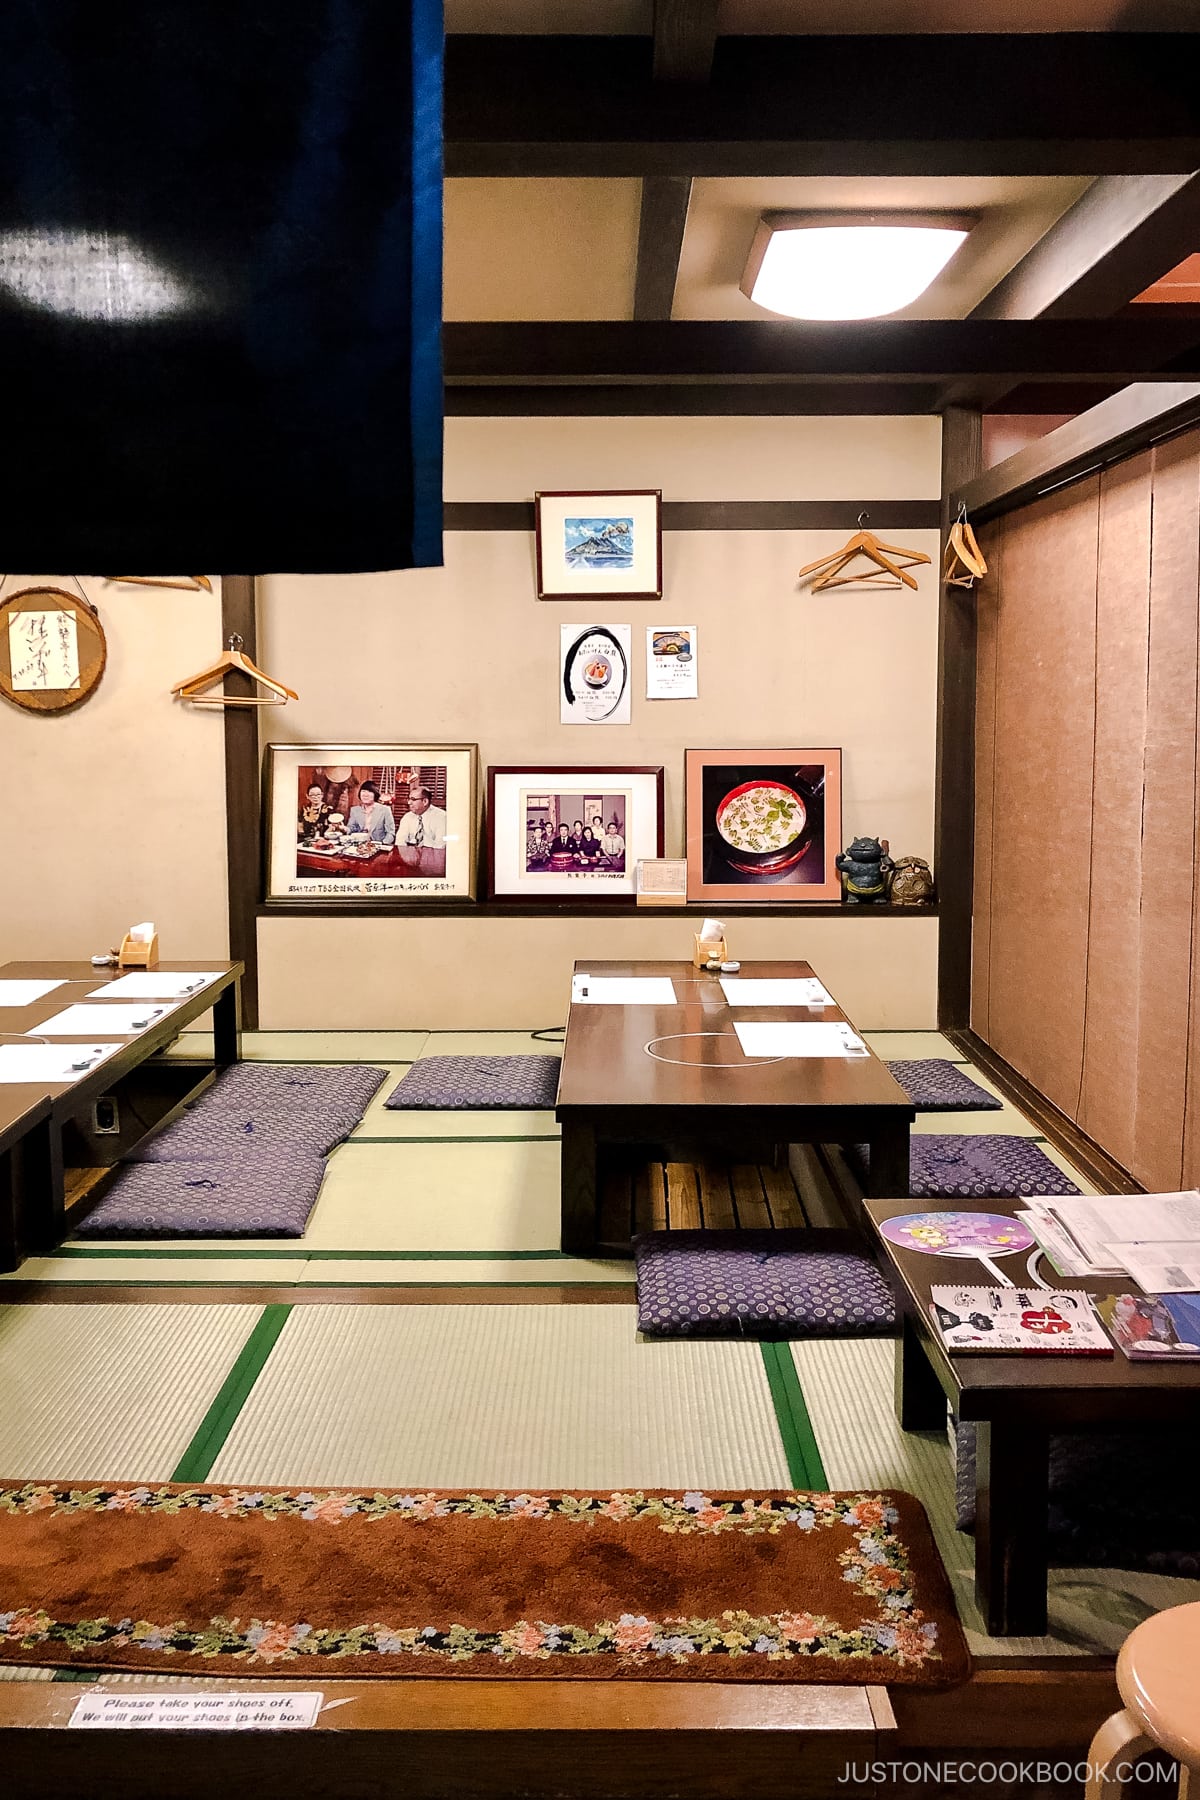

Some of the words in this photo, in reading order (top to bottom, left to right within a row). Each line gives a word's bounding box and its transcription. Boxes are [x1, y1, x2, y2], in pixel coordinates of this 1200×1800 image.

[103, 1699, 155, 1708] Please
[160, 1699, 189, 1708] take
[193, 1699, 224, 1709] your
[227, 1698, 266, 1708] shoes
[269, 1698, 294, 1708] off.
[82, 1712, 101, 1722] We
[104, 1712, 128, 1722] will
[129, 1712, 154, 1723] put
[158, 1713, 190, 1723] your
[193, 1712, 232, 1722] shoes
[235, 1712, 248, 1723] in
[253, 1712, 275, 1722] the
[279, 1712, 305, 1722] box.
